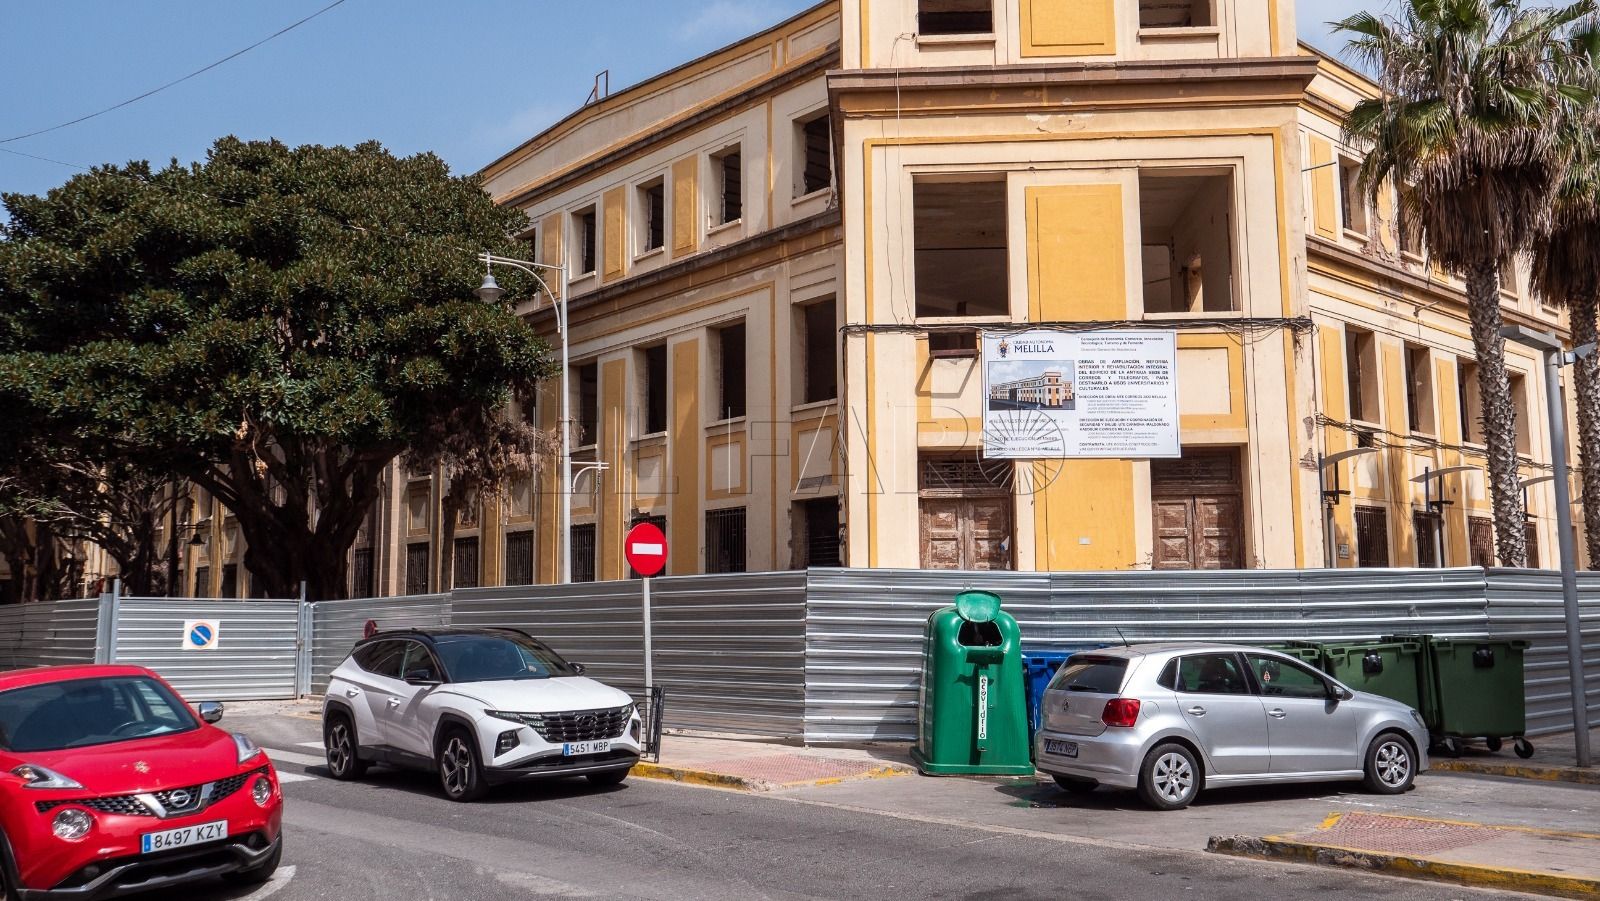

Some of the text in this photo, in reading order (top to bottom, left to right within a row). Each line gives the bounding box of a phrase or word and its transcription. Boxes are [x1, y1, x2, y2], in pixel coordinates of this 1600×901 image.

[570, 742, 608, 754] 5451 MBP
[154, 823, 223, 848] 8497 KZY
